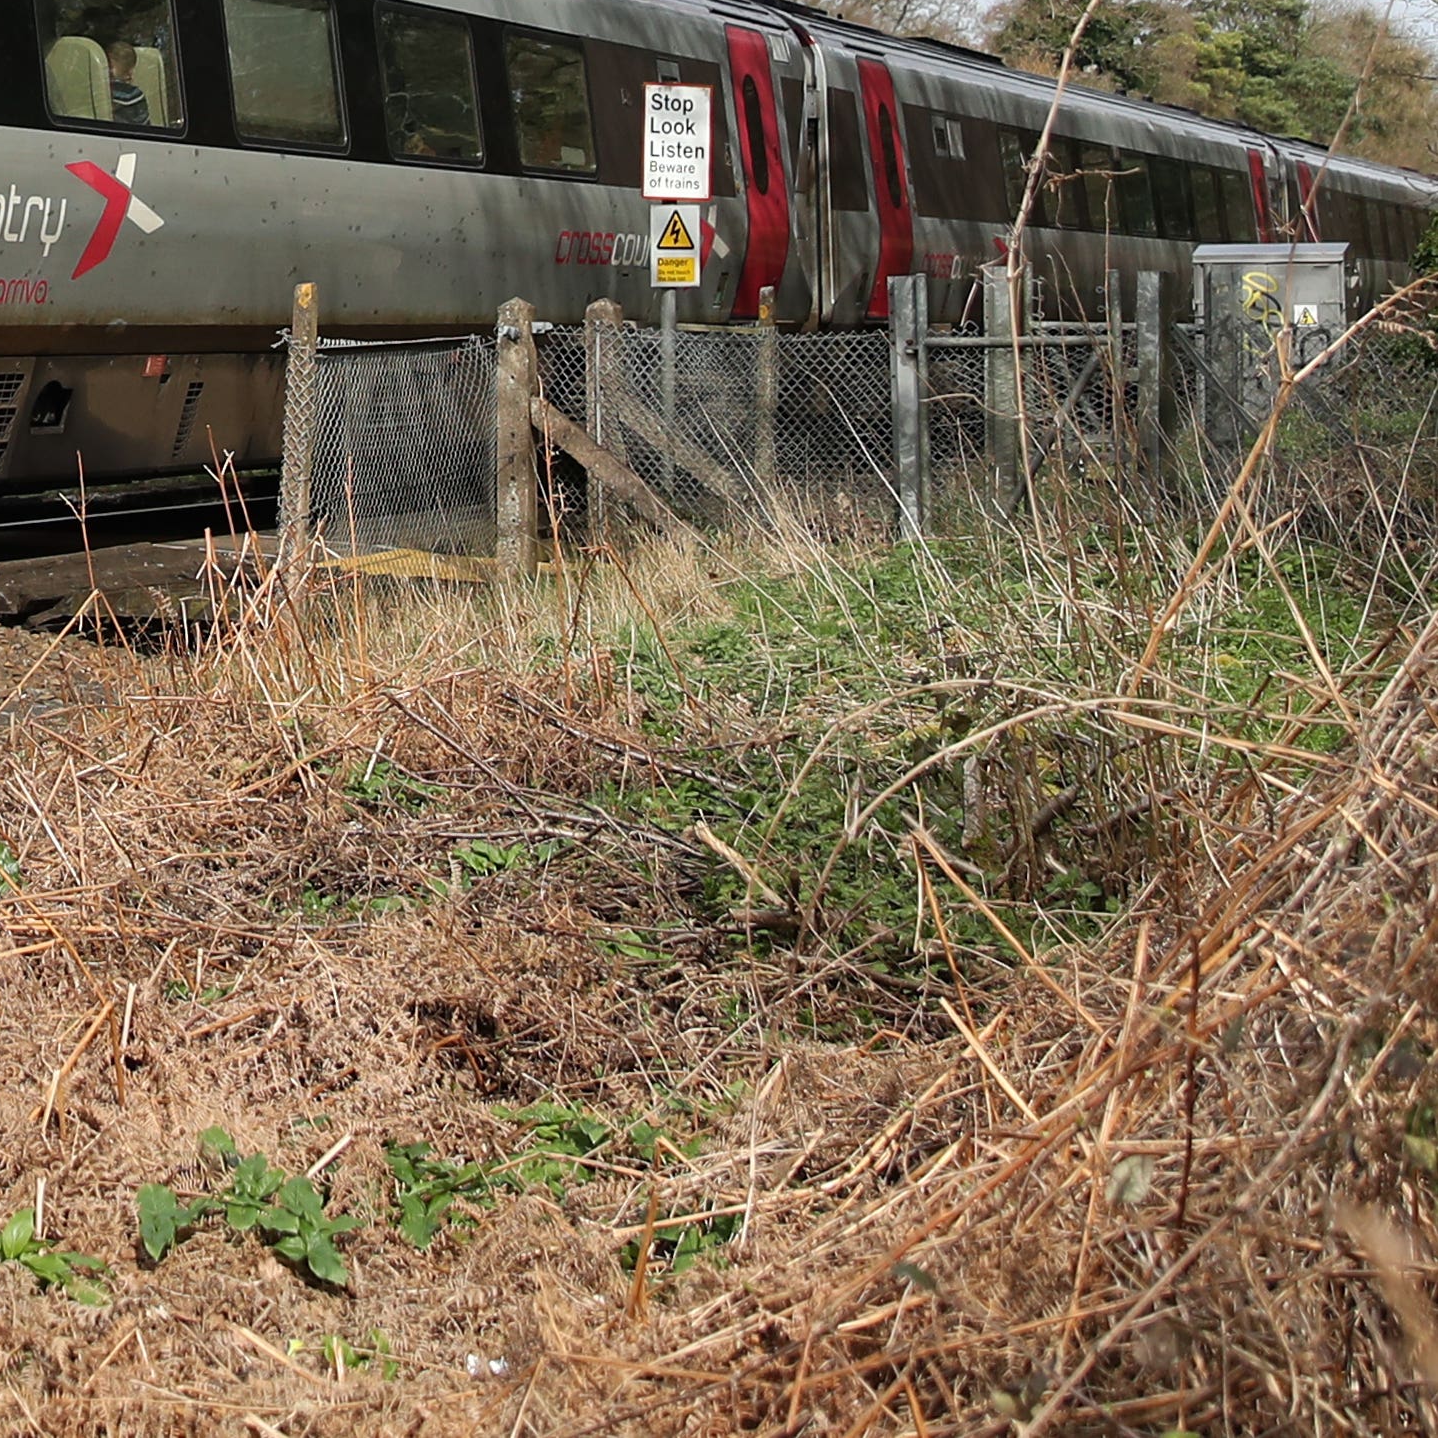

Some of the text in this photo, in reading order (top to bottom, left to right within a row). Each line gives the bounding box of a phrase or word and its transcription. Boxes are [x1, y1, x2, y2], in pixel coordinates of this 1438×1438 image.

[651, 93, 694, 116] Stop
[650, 116, 696, 136] Look
[650, 140, 705, 160] Listen
[649, 160, 696, 175] Beware
[649, 176, 701, 191] of trains
[657, 257, 689, 268] Danger
